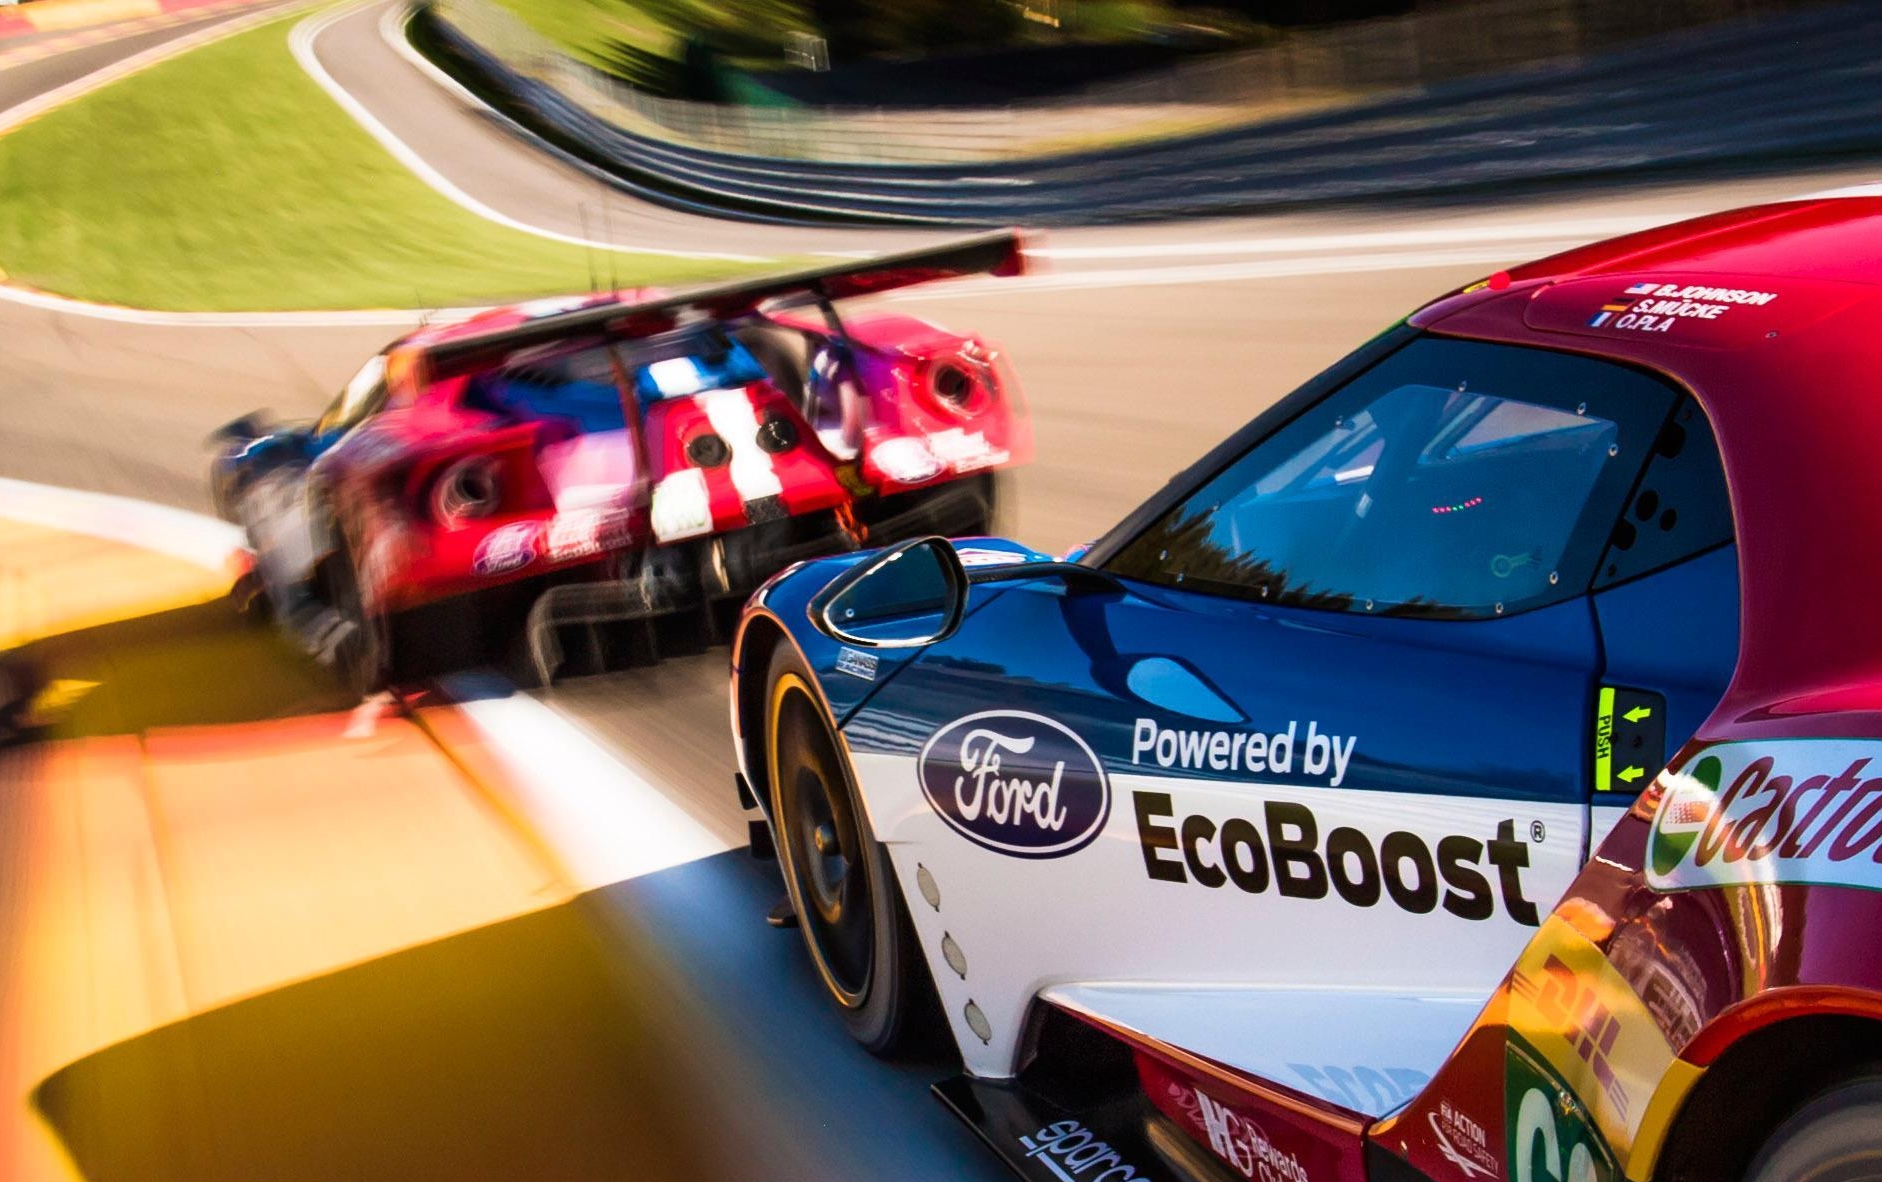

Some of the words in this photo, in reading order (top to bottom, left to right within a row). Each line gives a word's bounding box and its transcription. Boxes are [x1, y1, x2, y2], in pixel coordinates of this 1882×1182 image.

[1632, 298, 1730, 320] S.MÜCKE
[1653, 283, 1778, 306] B.JOHNSON
[1615, 313, 1676, 333] O.PLA
[1131, 717, 1298, 774] Powered
[1303, 720, 1358, 787] by
[1597, 714, 1612, 760] PUSH
[954, 728, 1068, 832] Ford
[1454, 1110, 1486, 1148] ACTION
